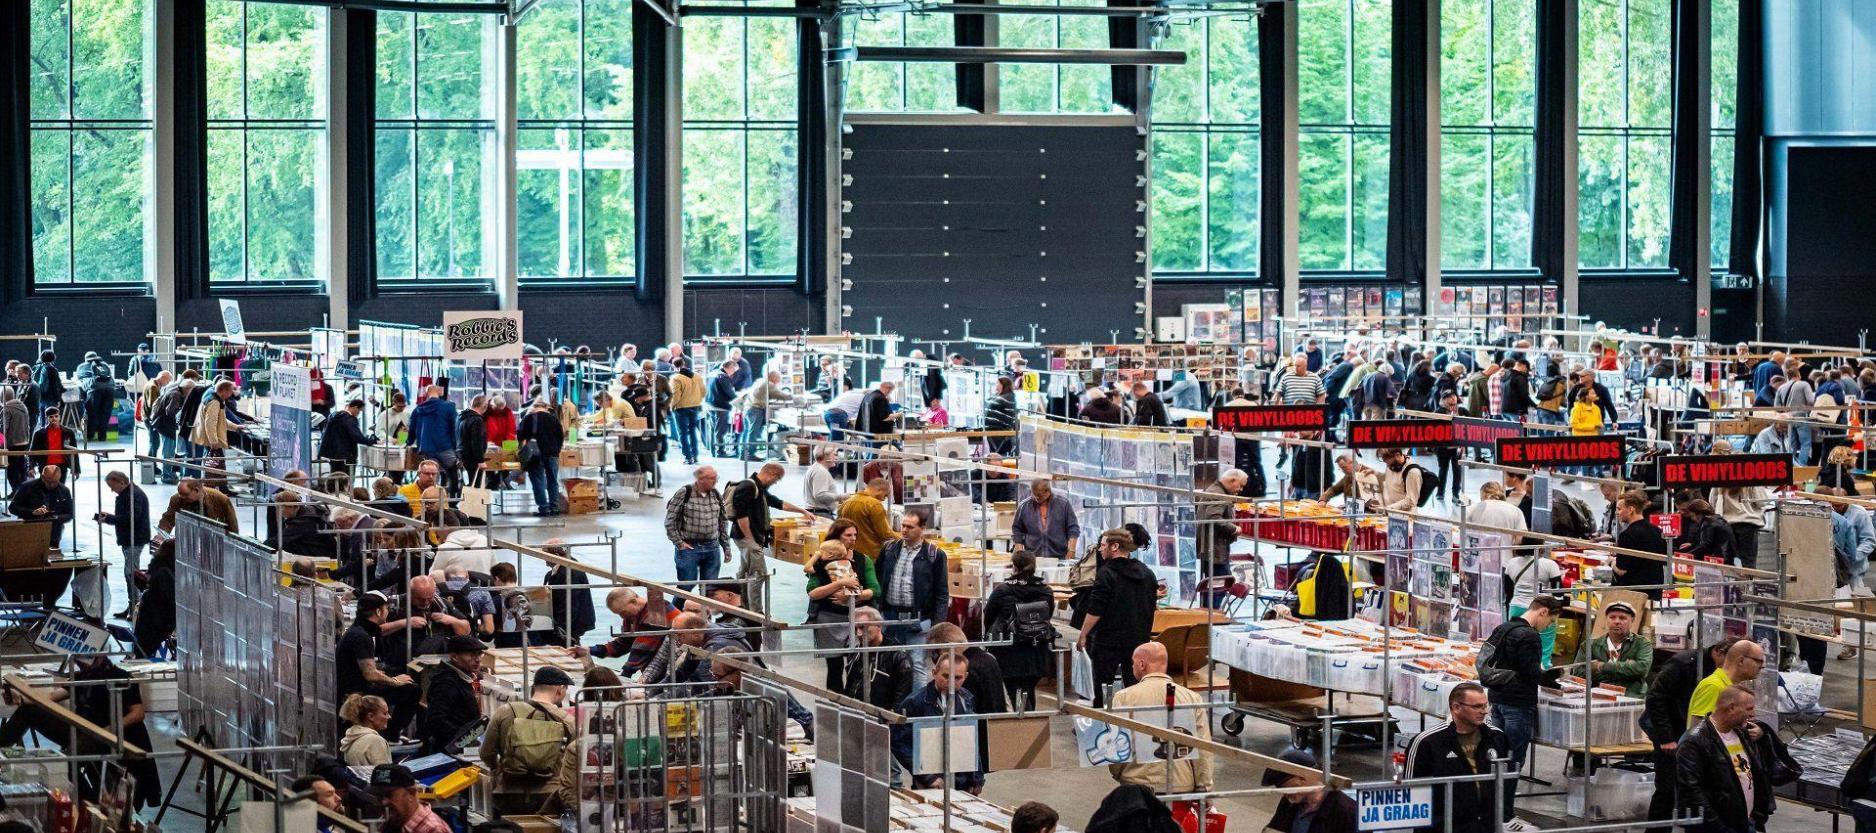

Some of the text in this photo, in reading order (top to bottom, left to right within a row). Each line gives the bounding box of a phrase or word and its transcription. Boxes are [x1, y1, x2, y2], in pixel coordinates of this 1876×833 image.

[449, 317, 517, 337] Robbie's
[450, 330, 519, 352] Records
[278, 373, 298, 386] RECORD
[278, 385, 296, 400] PLANET
[1217, 409, 1324, 427] DE VINYLLOODS
[1353, 423, 1452, 443] DE VINYLLOOD
[1455, 423, 1466, 440] DE
[1502, 441, 1620, 462] DE VINYLLOODS
[1665, 461, 1787, 482] DE VINYLLOODS
[41, 630, 58, 644] JA
[47, 617, 91, 642] PINNEN
[1362, 788, 1411, 806] PINNEN
[1361, 803, 1430, 823] JA GRAAG
